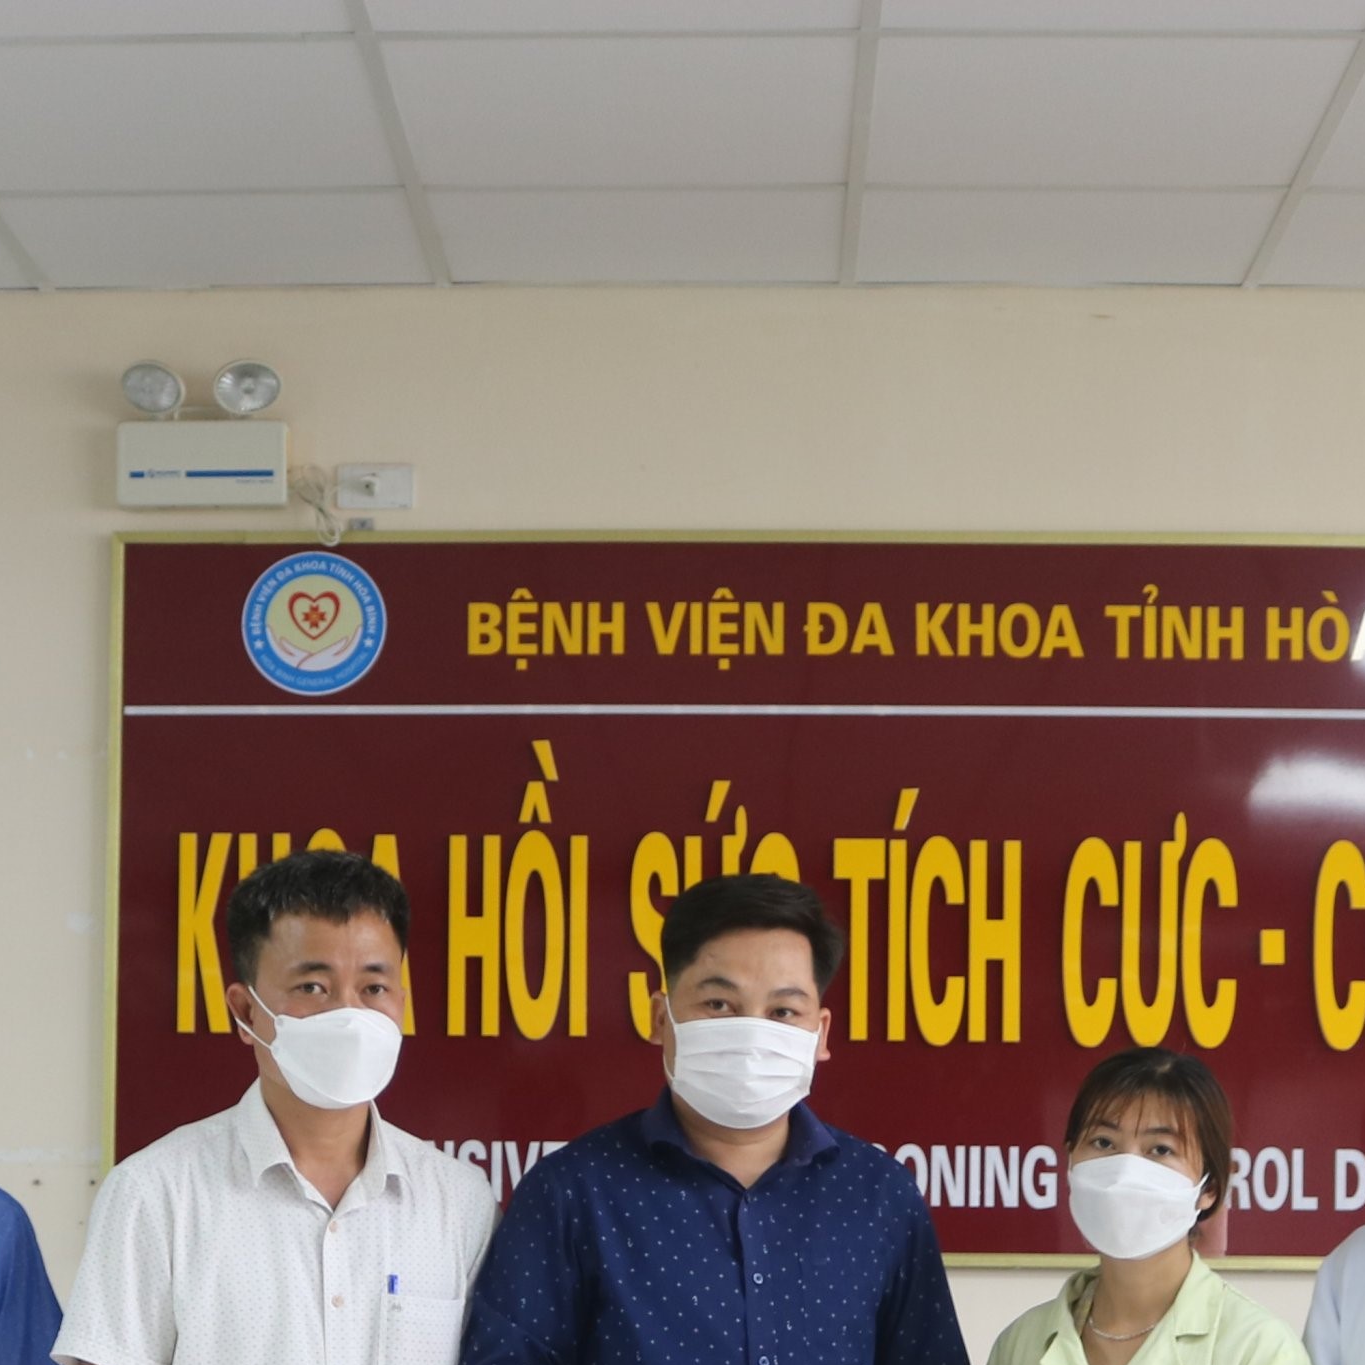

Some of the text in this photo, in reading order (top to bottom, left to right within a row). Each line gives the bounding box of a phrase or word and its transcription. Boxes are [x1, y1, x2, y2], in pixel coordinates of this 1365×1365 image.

[467, 587, 625, 670] BỆNH
[646, 587, 785, 670] VIỆN
[803, 601, 895, 656] ĐA
[915, 602, 1084, 659] KHOA
[1105, 583, 1245, 661] TỈNH
[447, 739, 589, 1041] HỒI
[833, 787, 1022, 1047] TÍCH
